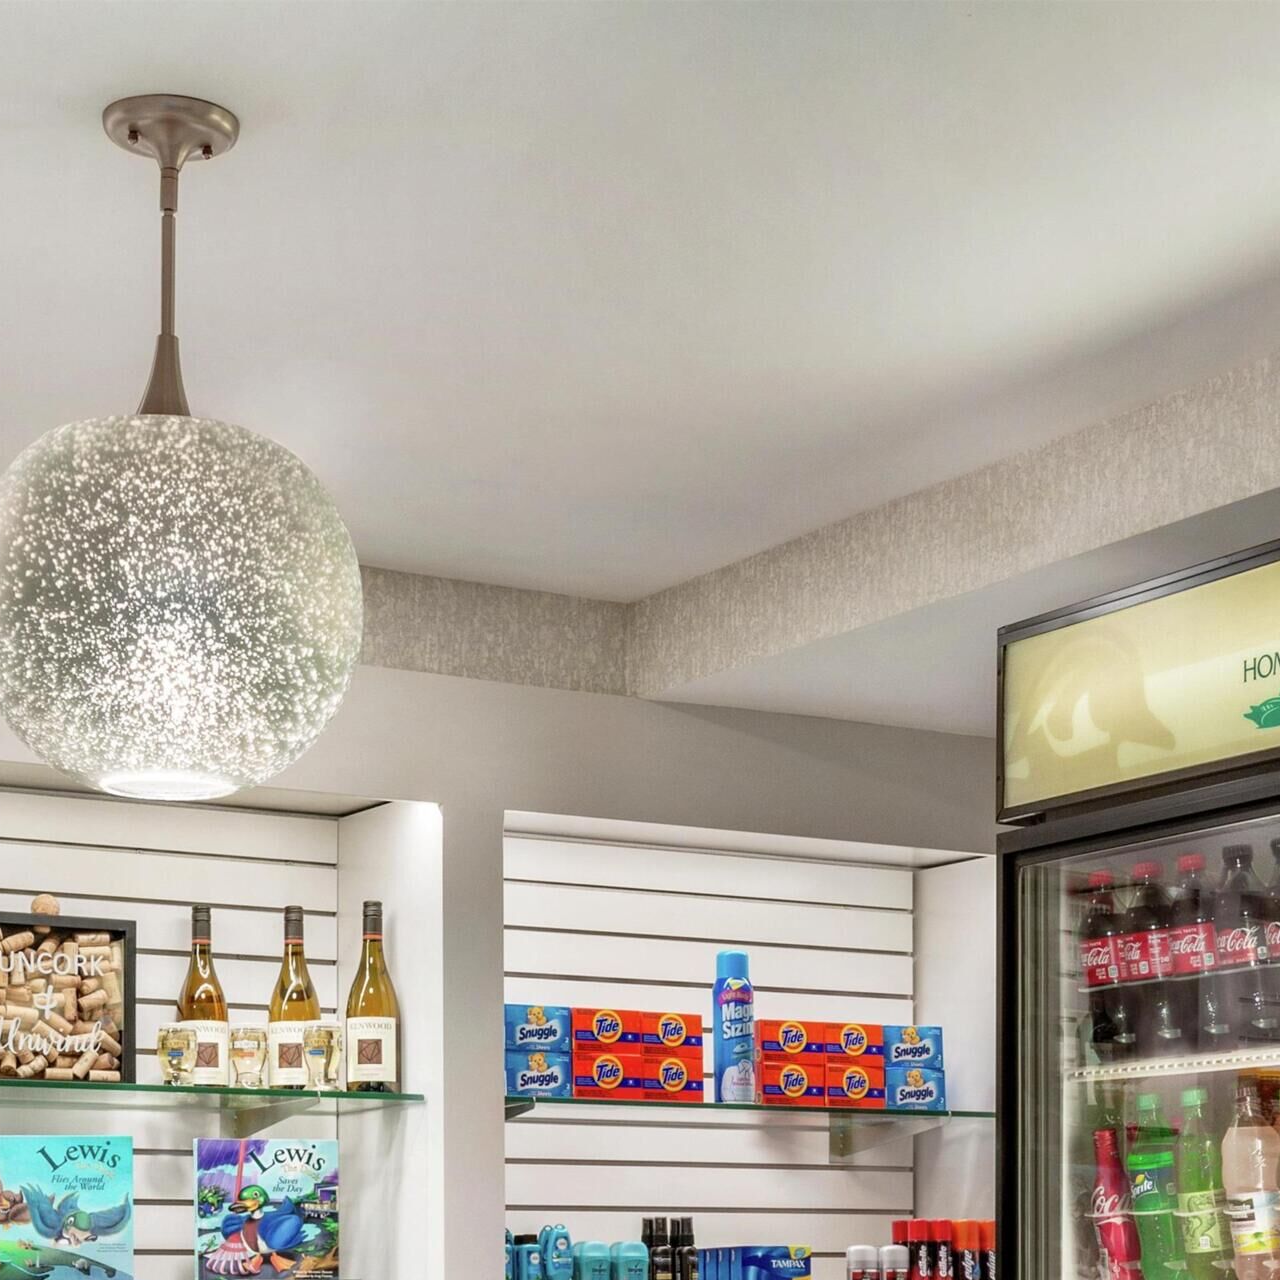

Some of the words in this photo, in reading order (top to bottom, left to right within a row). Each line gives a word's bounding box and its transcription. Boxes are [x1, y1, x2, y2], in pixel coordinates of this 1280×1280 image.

[519, 1025, 558, 1041] Snuggle
[595, 1018, 619, 1035] Tide
[660, 1023, 683, 1039] Tide
[782, 1029, 805, 1045] Tide
[843, 1032, 865, 1048] Tide
[894, 1045, 931, 1060] Snuggle
[520, 1072, 559, 1087] Snuggle
[596, 1064, 621, 1081] Tide
[662, 1068, 685, 1084] Tide
[783, 1073, 805, 1089] Tide
[845, 1075, 867, 1091] Tide
[898, 1088, 934, 1101] Snuggle
[37, 1140, 121, 1173] Lewis
[247, 1144, 326, 1175] Lewis
[51, 1174, 70, 1183] Flies
[72, 1175, 104, 1183] Around
[64, 1183, 78, 1191] the
[80, 1183, 105, 1191] World
[272, 1184, 285, 1192] the
[287, 1184, 303, 1194] Day
[771, 1258, 807, 1270] TAMPAX
